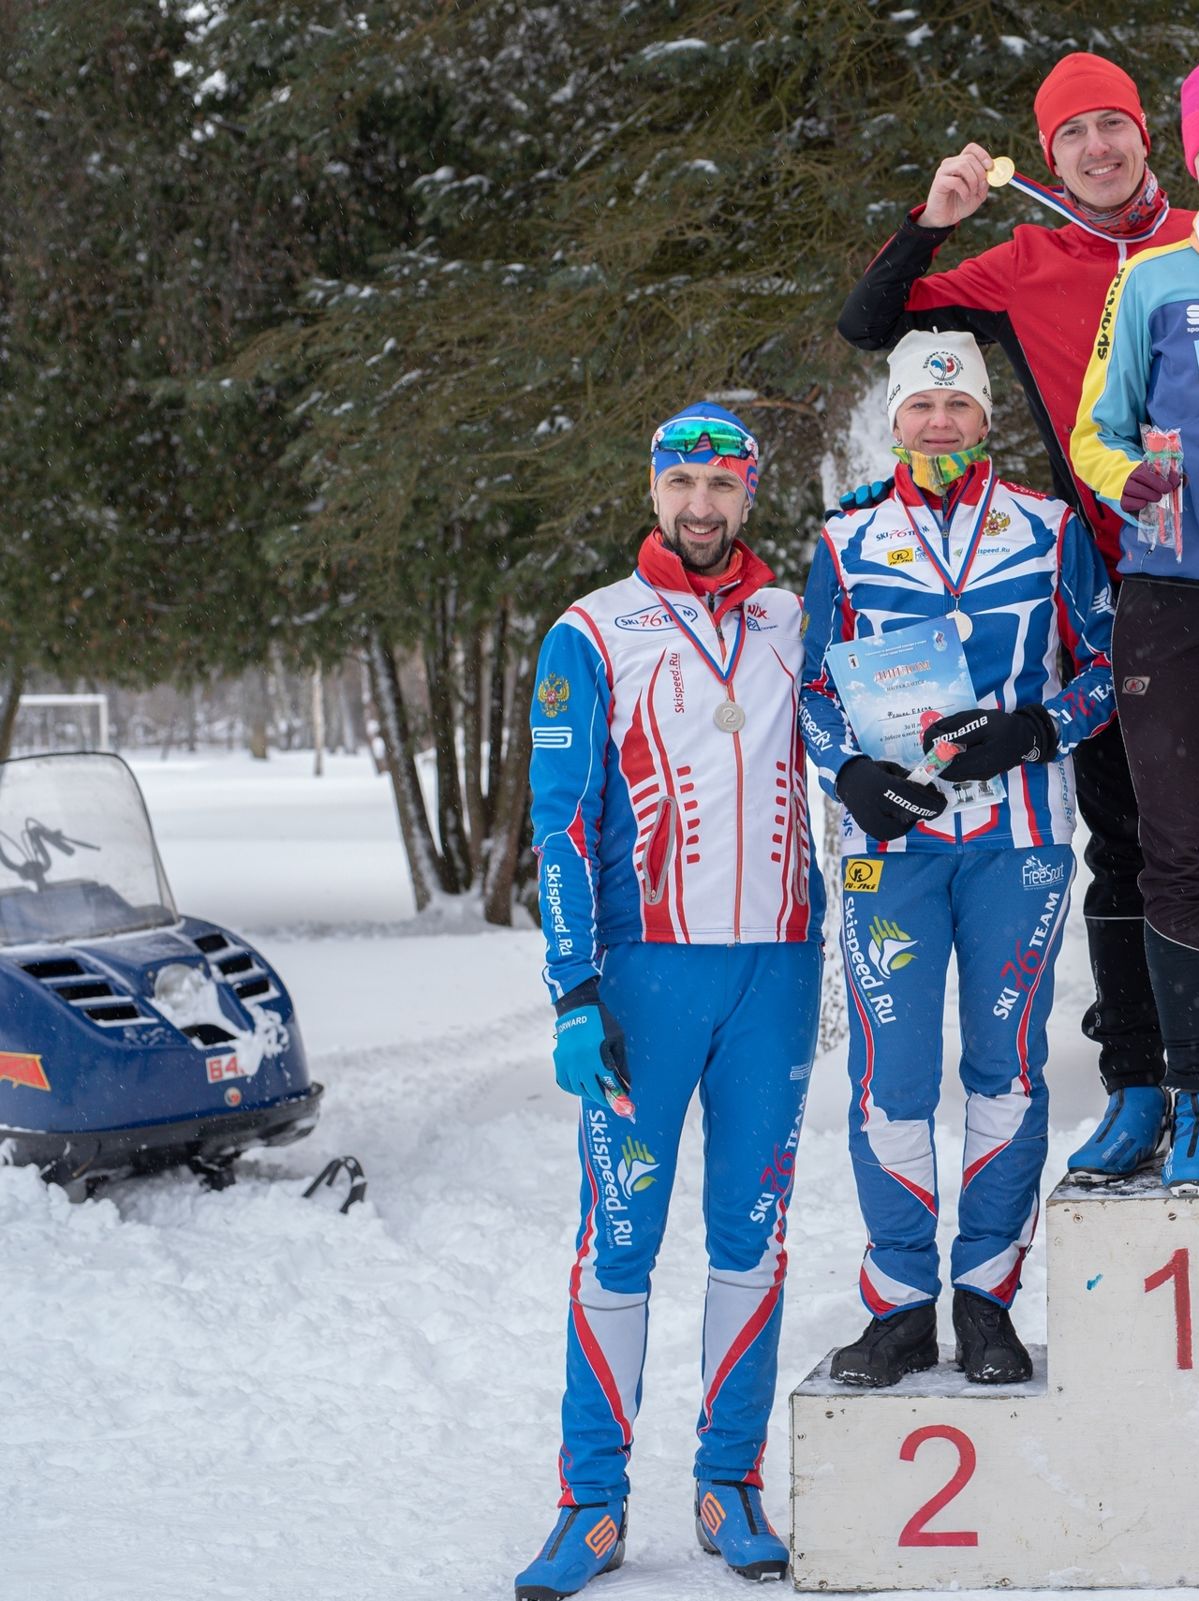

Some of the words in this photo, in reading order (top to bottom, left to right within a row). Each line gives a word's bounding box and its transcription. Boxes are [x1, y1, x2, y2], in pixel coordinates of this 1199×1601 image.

[639, 610, 662, 627] 76
[670, 652, 685, 713] Skispeed.Ru
[723, 708, 736, 725] 2
[932, 715, 989, 746] noname
[883, 789, 938, 818] noname
[546, 863, 574, 956] Skispeed.Ru
[1028, 892, 1061, 948] TEAM
[844, 896, 897, 1024] Skispeed.Ru
[1000, 938, 1041, 993] 76
[992, 986, 1020, 1020] SKI
[588, 1109, 633, 1246] Skispeed.Ru
[750, 1192, 776, 1224] SKI
[1144, 1248, 1193, 1370] 1
[898, 1425, 979, 1547] 2
